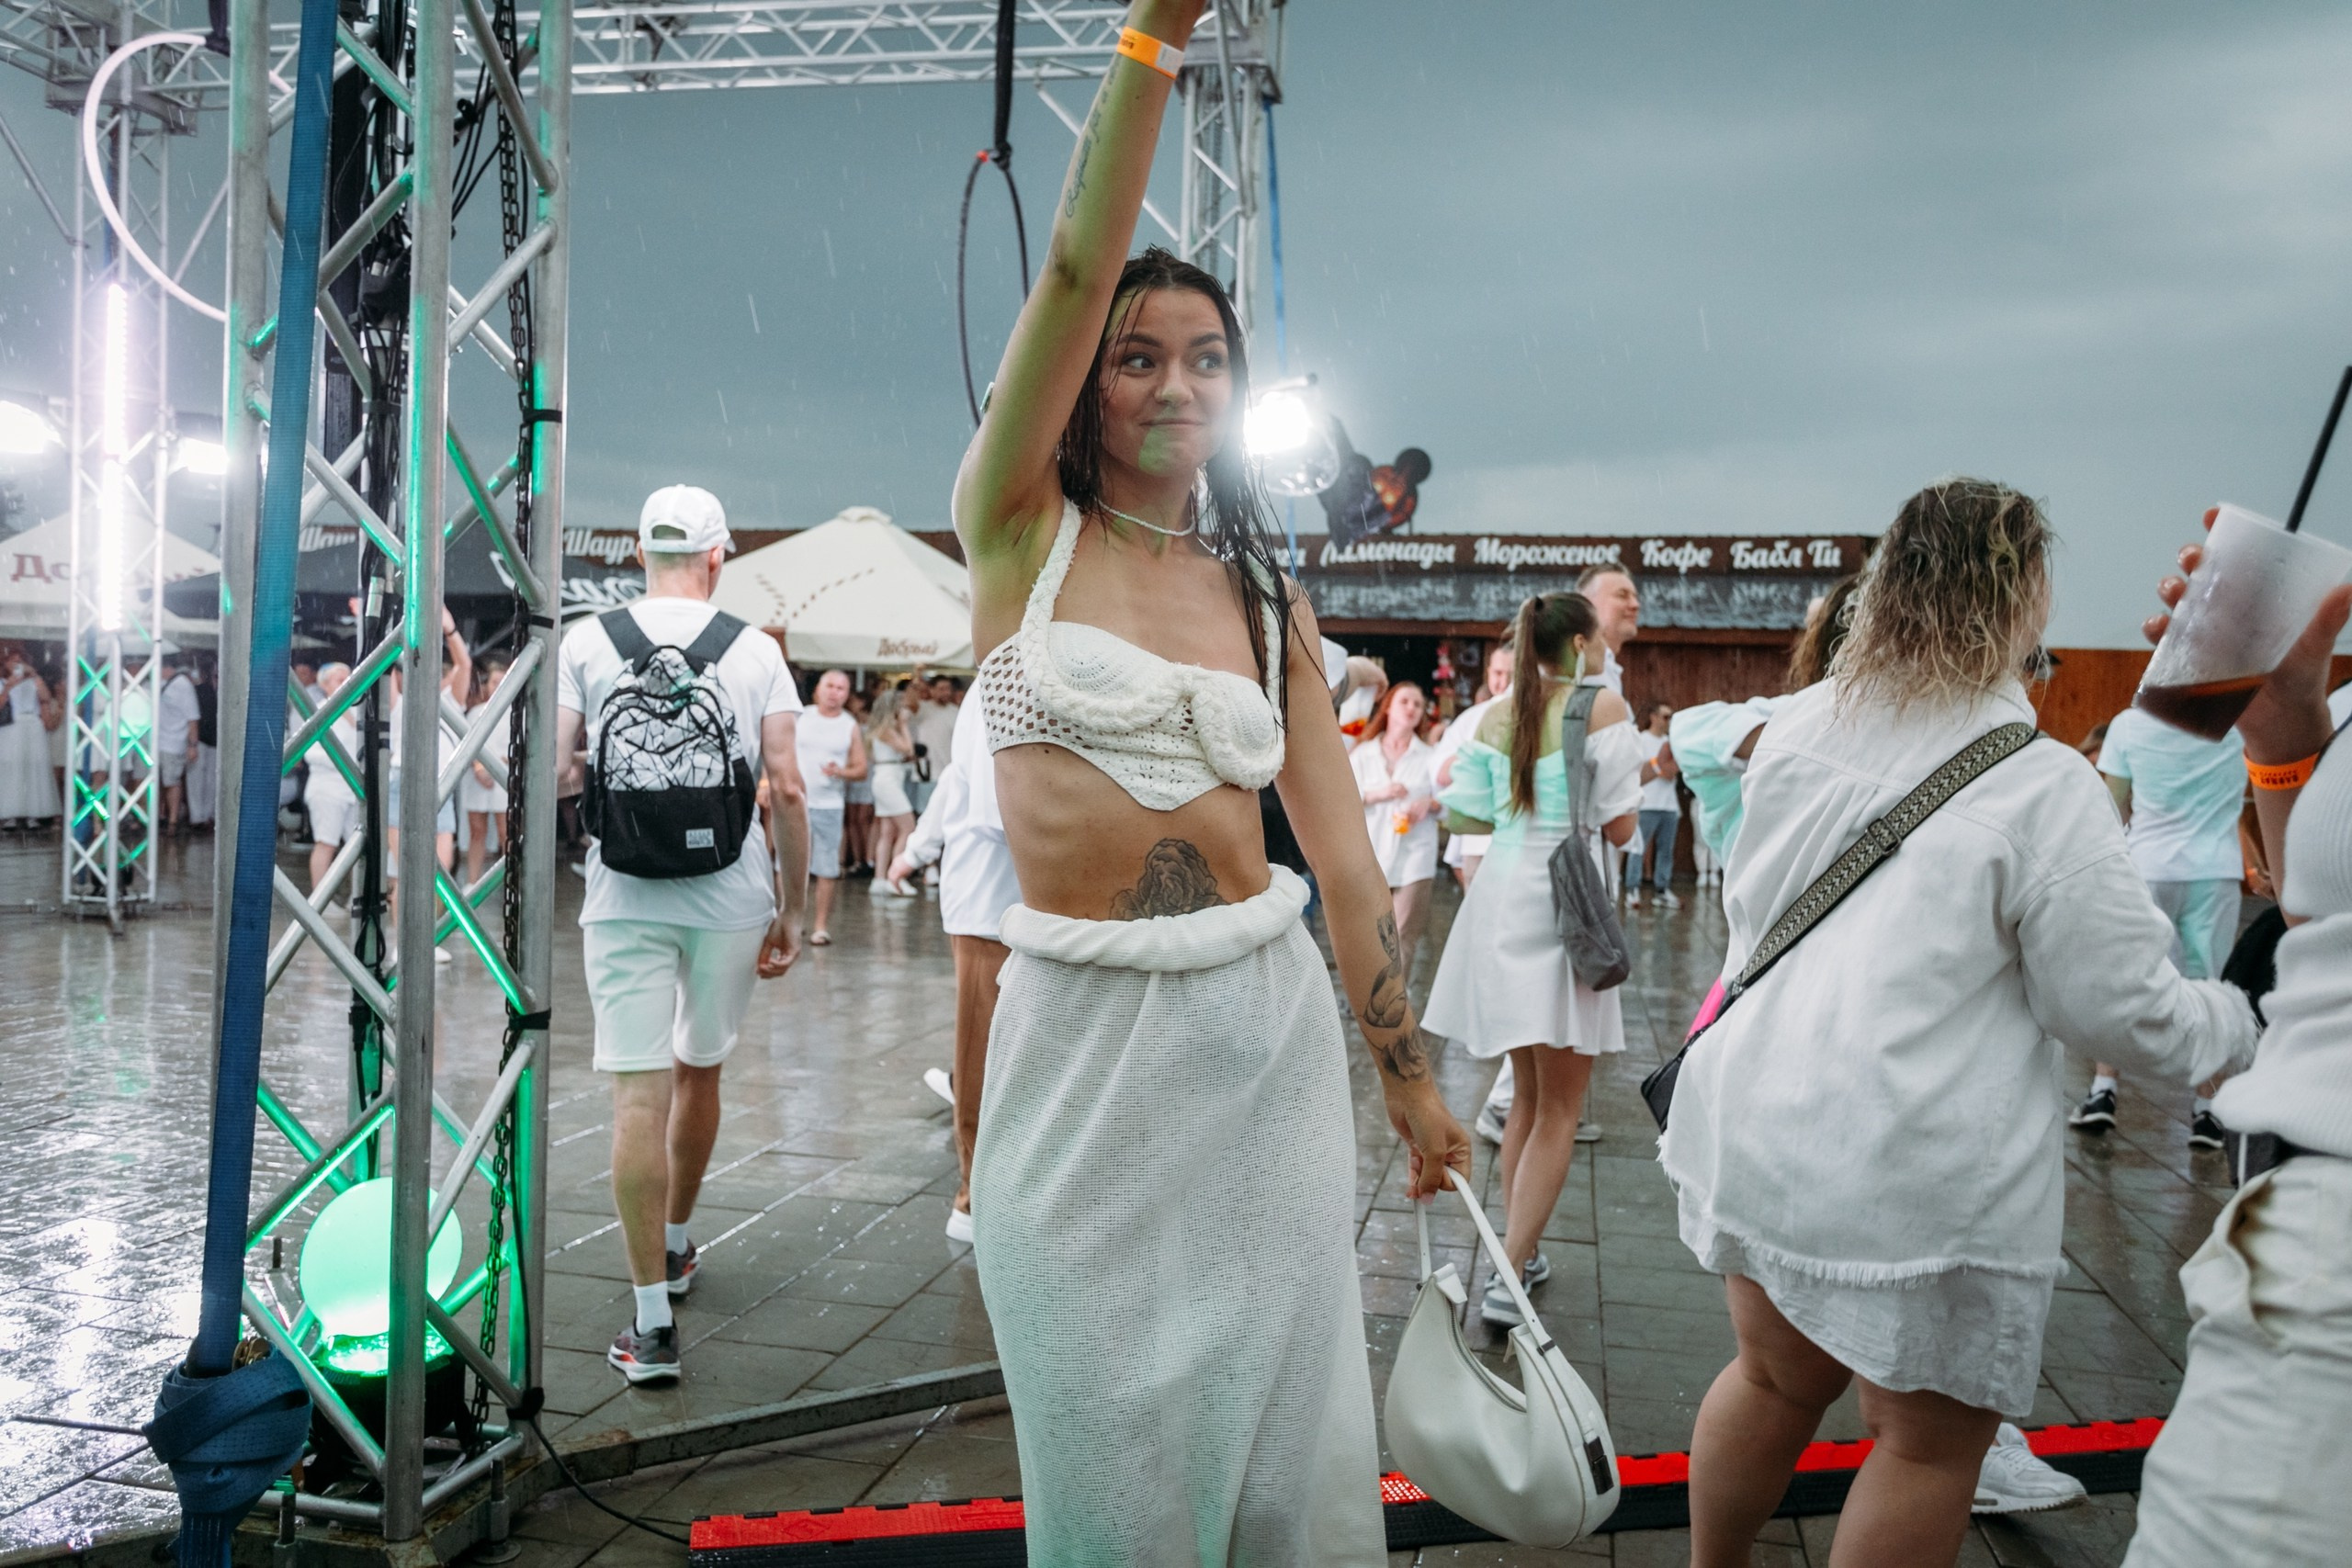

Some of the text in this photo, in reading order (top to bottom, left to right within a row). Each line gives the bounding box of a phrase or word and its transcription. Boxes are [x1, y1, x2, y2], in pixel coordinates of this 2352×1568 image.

[1474, 537, 1622, 571] Мороженое
[1640, 539, 1713, 574] Кофе
[1730, 540, 1803, 569] Бабл
[1807, 539, 1842, 568] Ти
